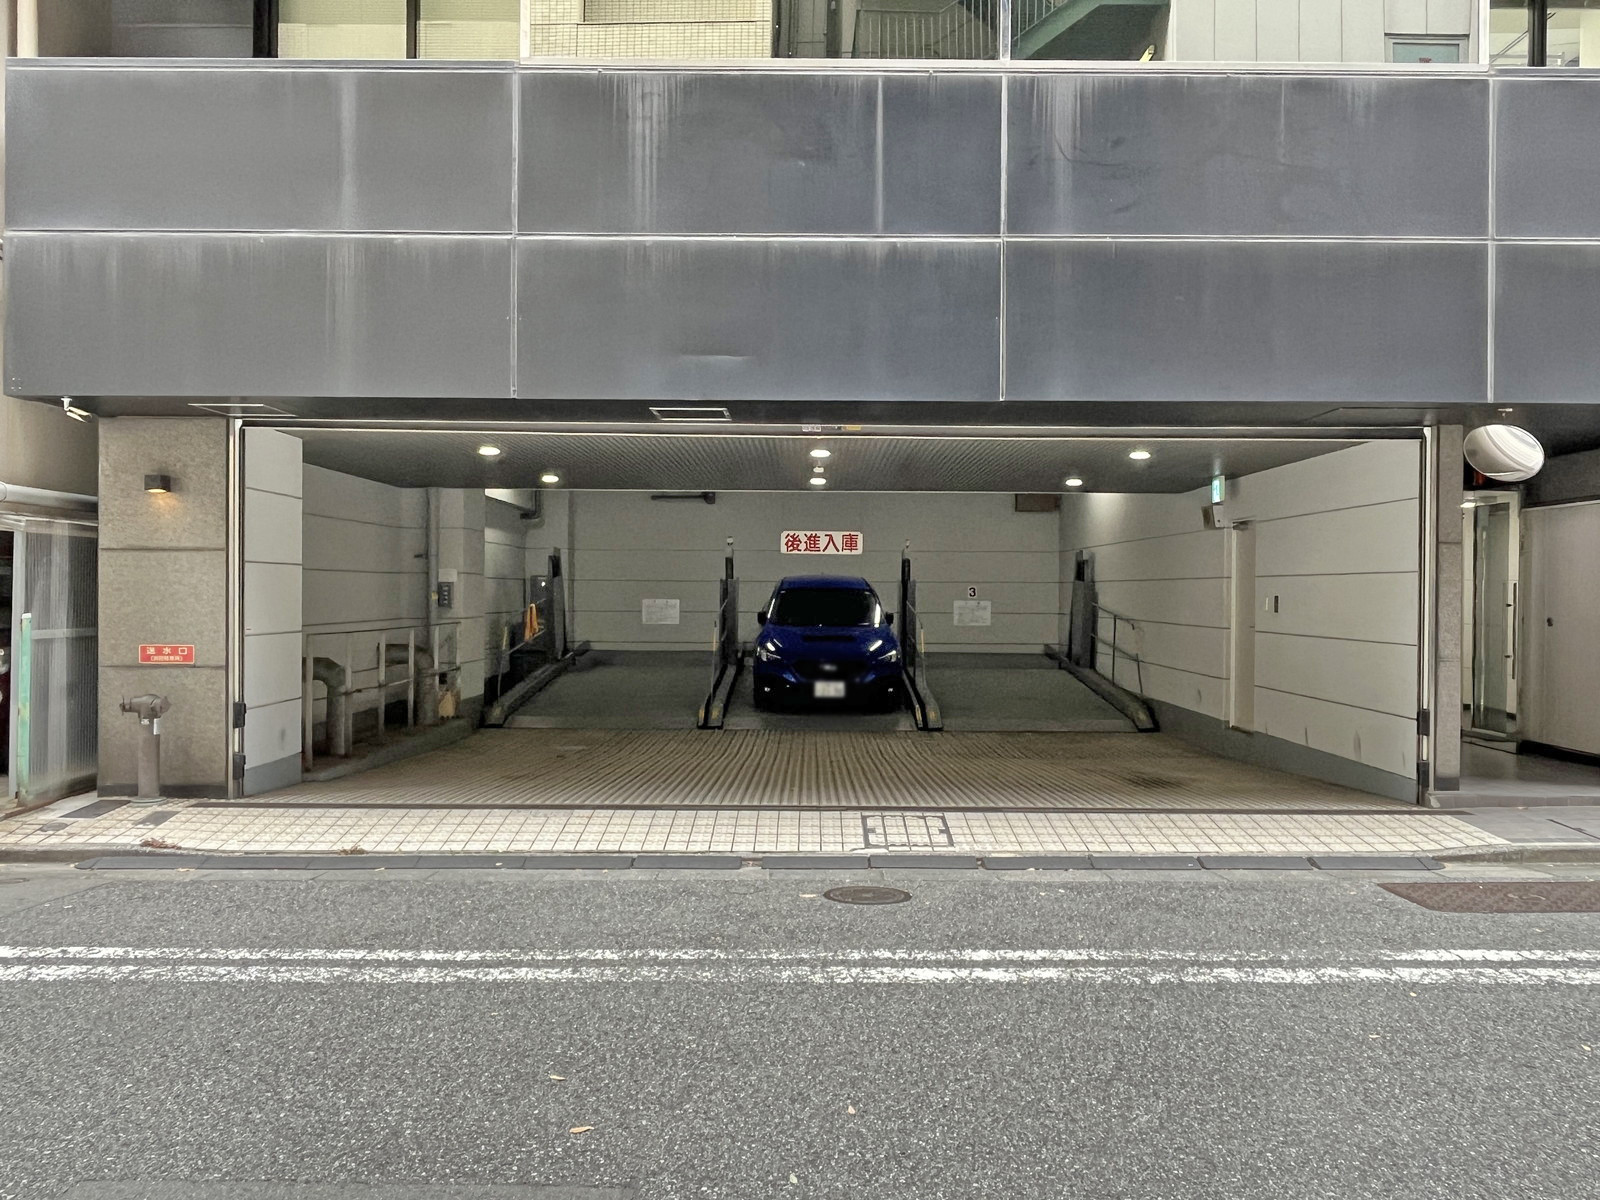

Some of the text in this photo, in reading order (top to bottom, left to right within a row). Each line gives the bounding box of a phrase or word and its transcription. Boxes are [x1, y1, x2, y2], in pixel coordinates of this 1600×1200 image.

[784, 533, 859, 553] 後進入庫
[969, 587, 976, 597] 3
